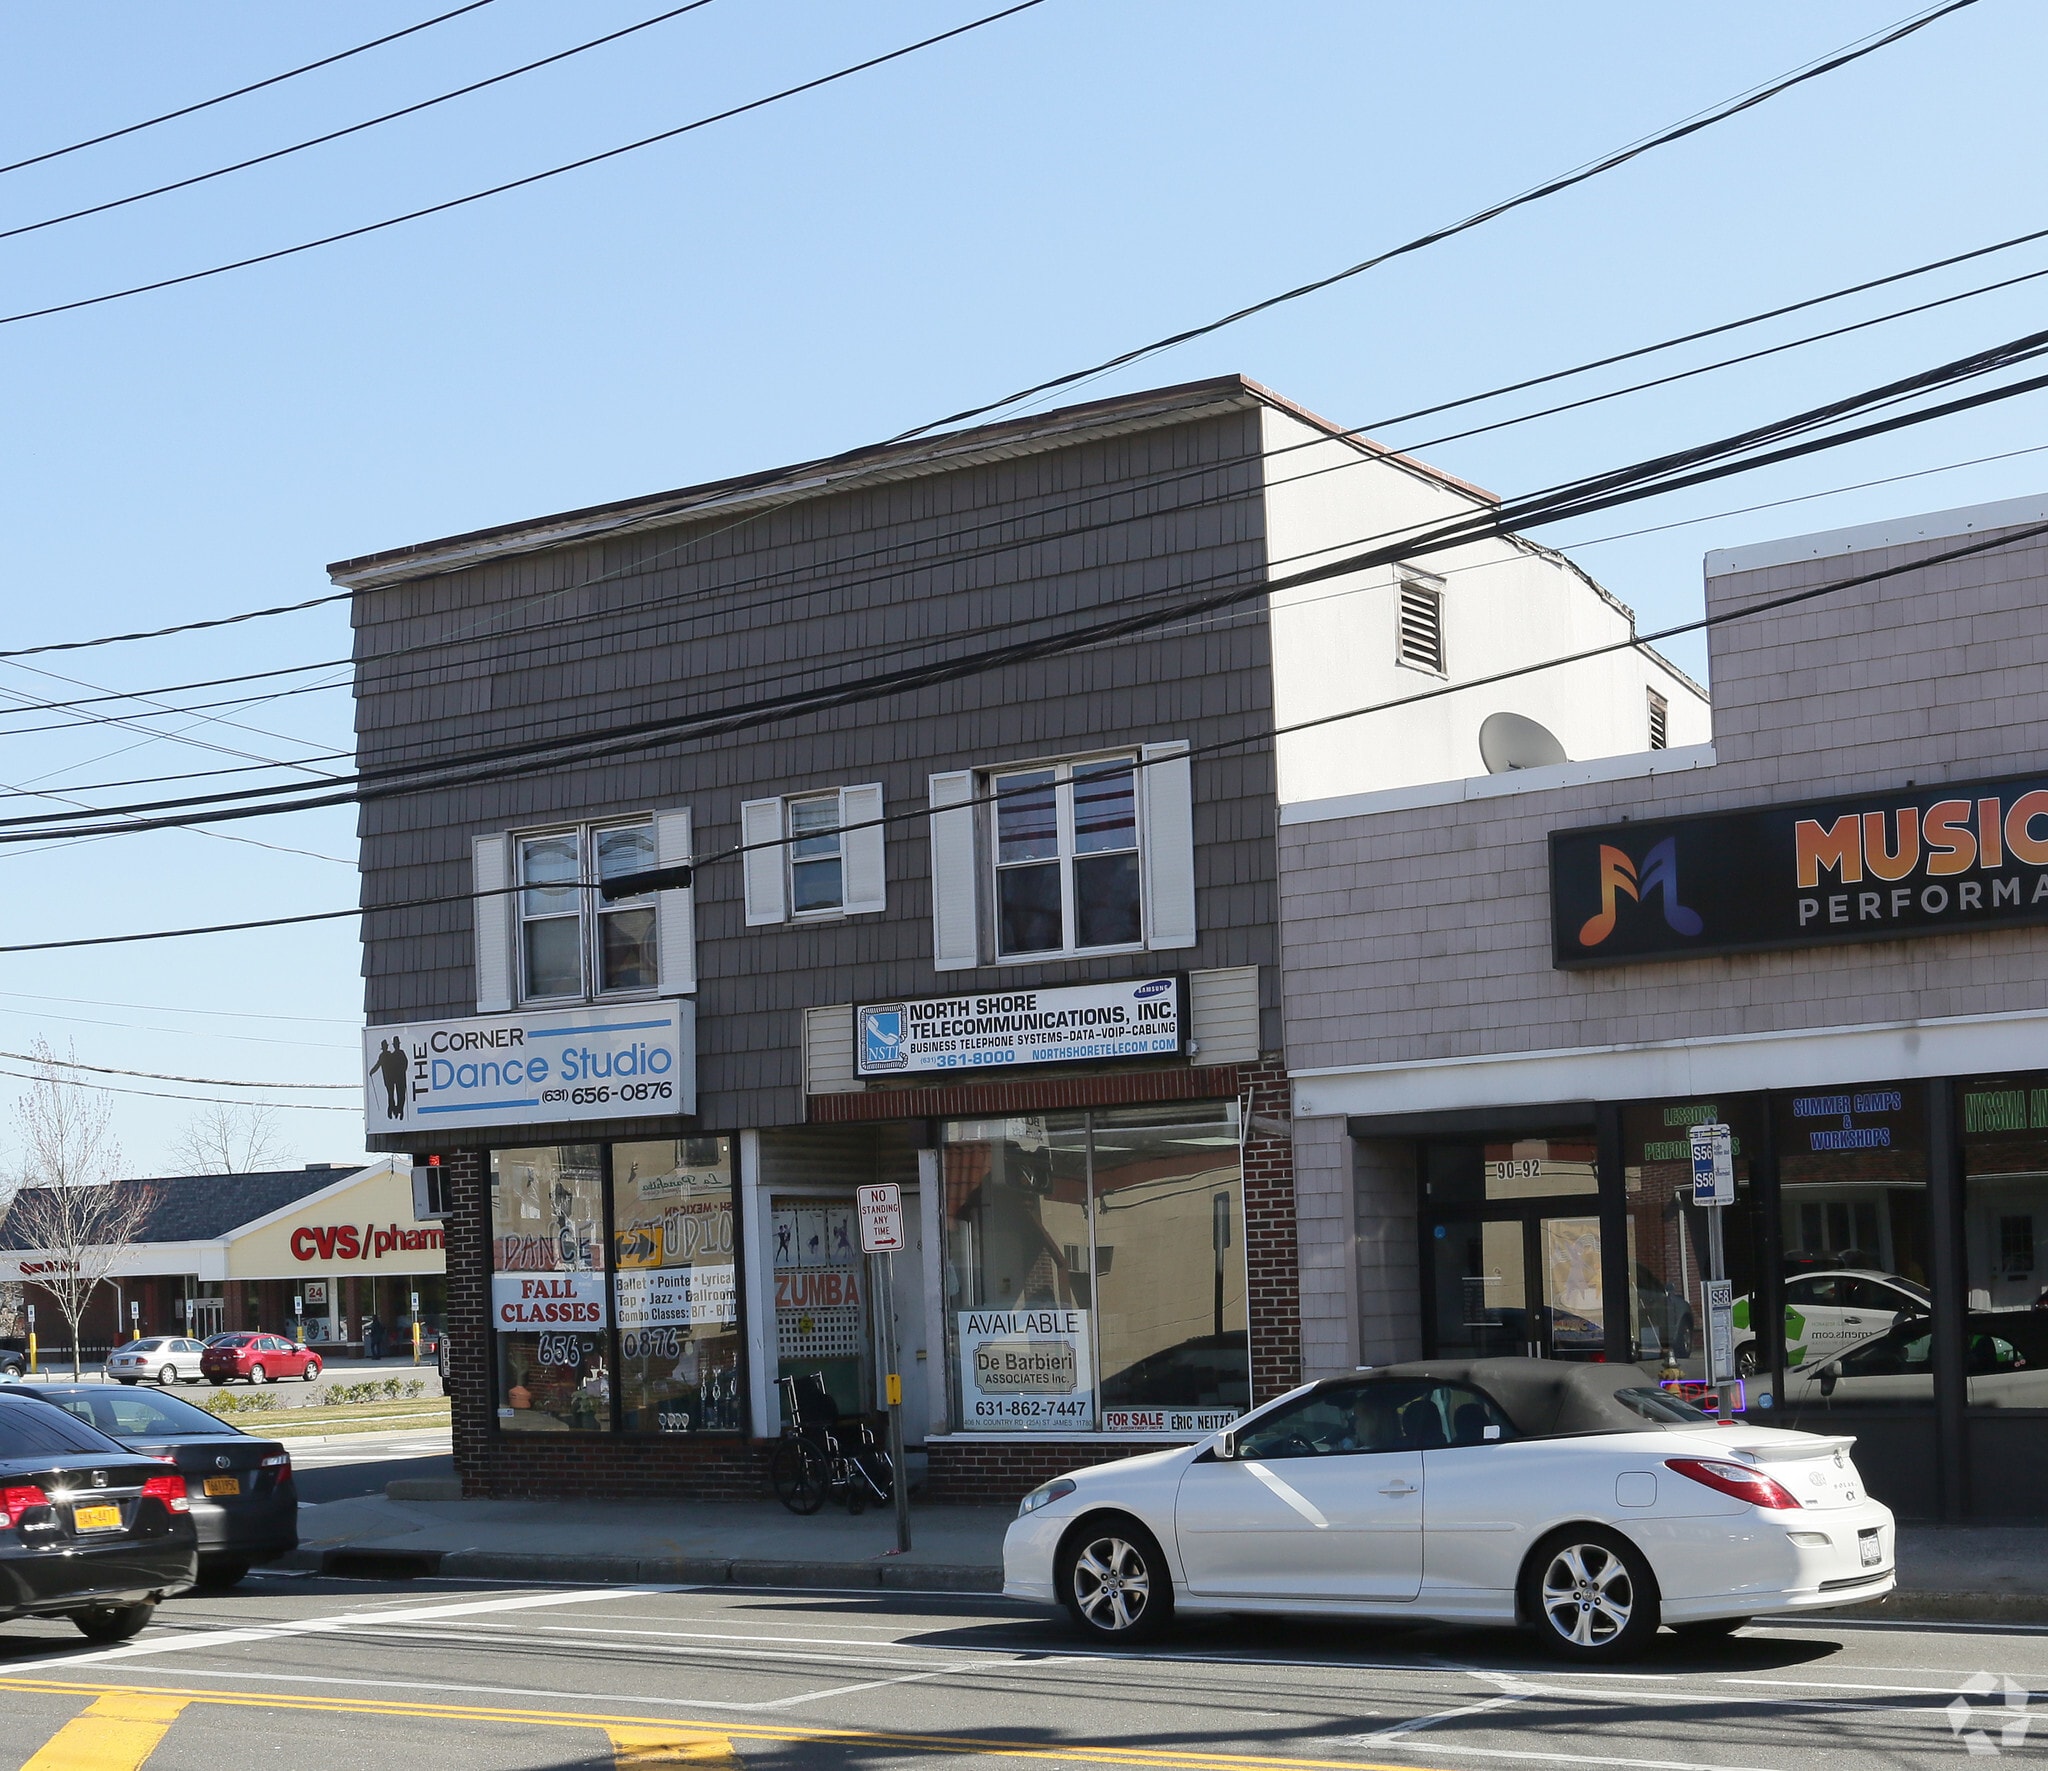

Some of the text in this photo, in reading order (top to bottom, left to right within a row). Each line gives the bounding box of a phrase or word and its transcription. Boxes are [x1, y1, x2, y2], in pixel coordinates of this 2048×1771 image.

[1795, 788, 2048, 888] MUSIC
[910, 994, 1036, 1021] NORTH SHORE
[911, 1001, 1177, 1040] TELECOMMUNICATIONS, INC.
[430, 1027, 524, 1053] CORNER
[910, 1040, 957, 1054] BUSINESS
[960, 1035, 1014, 1050] TELEPHONE
[432, 1042, 672, 1091] Dance Studio
[920, 1049, 1016, 1068] (631) 361-8000
[412, 1041, 430, 1103] THE
[541, 1081, 672, 1105] (631) 656-0876
[1793, 1091, 1901, 1117] SUMMER CAMPS
[1964, 1090, 2027, 1133] NYSSMA
[1664, 1105, 1718, 1126] LESSONS
[1843, 1114, 1852, 1130] &
[1810, 1127, 1891, 1150] WORKSHOPS
[1693, 1145, 1713, 1161] S56
[1497, 1159, 1540, 1180] 90-92
[1695, 1172, 1715, 1188] S58
[870, 1189, 887, 1203] NO
[862, 1203, 898, 1215] STANDING
[873, 1216, 889, 1225] ANY
[626, 1211, 734, 1261] STUDIO
[873, 1226, 890, 1236] TIME
[503, 1221, 593, 1271] DANCE
[521, 1279, 577, 1298] FALL
[616, 1277, 646, 1291] Ballet
[658, 1274, 691, 1288] Pointe
[774, 1274, 860, 1307] ZUMBA
[308, 1287, 323, 1298] 24
[617, 1289, 737, 1308] Tap Jazz Ballroom
[1711, 1289, 1730, 1306] S58
[501, 1303, 600, 1322] CLASSES
[619, 1309, 649, 1322] Combo
[652, 1307, 689, 1320] Classes:
[967, 1312, 1080, 1335] AVAILABLE
[623, 1327, 680, 1360] 0876
[977, 1352, 1073, 1371] De Barbieri
[985, 1373, 1070, 1385] ASSOCIATES Inc.
[975, 1401, 1086, 1417] 631-862-7447
[1106, 1412, 1164, 1426] FOR SALE
[1171, 1414, 1193, 1430] ERIC
